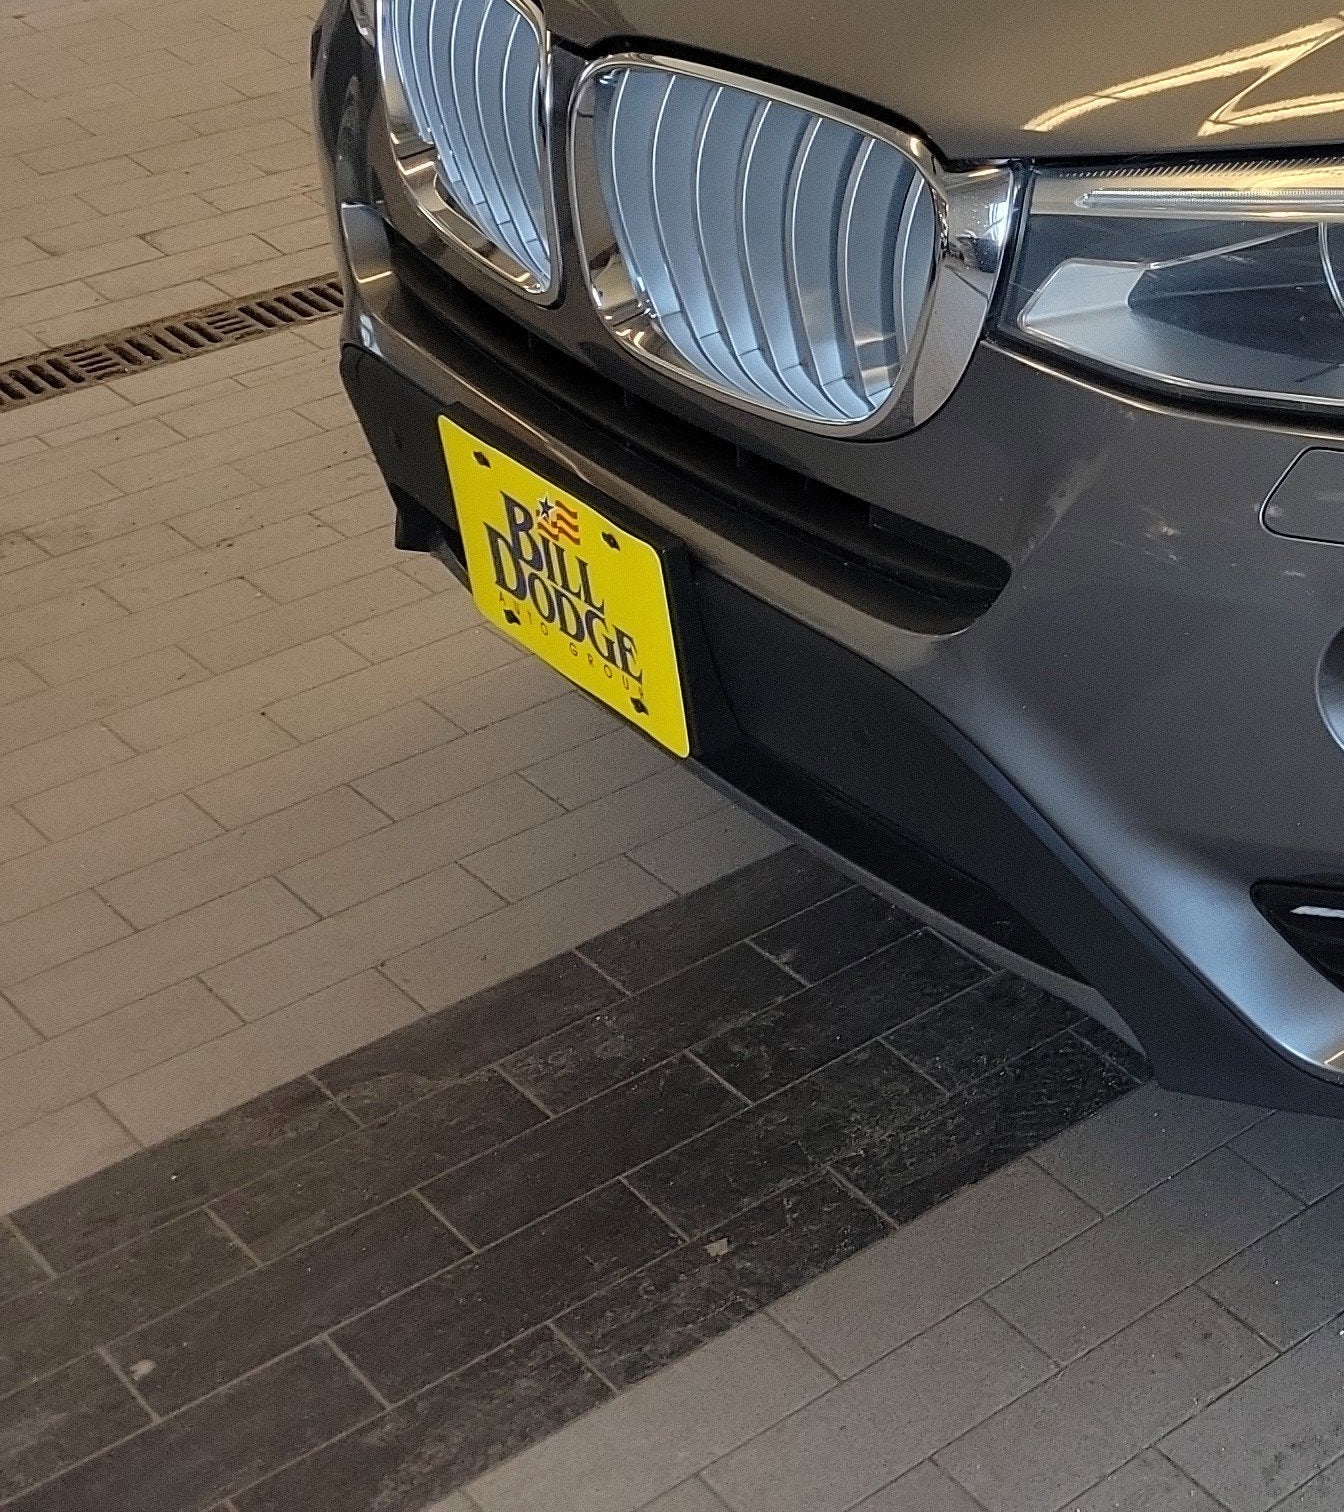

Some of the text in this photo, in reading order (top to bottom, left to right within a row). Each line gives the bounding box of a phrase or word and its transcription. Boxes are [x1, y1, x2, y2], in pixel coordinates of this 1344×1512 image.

[483, 521, 643, 684] DODGE
[499, 591, 549, 636] AUTO
[500, 490, 605, 616] BILL
